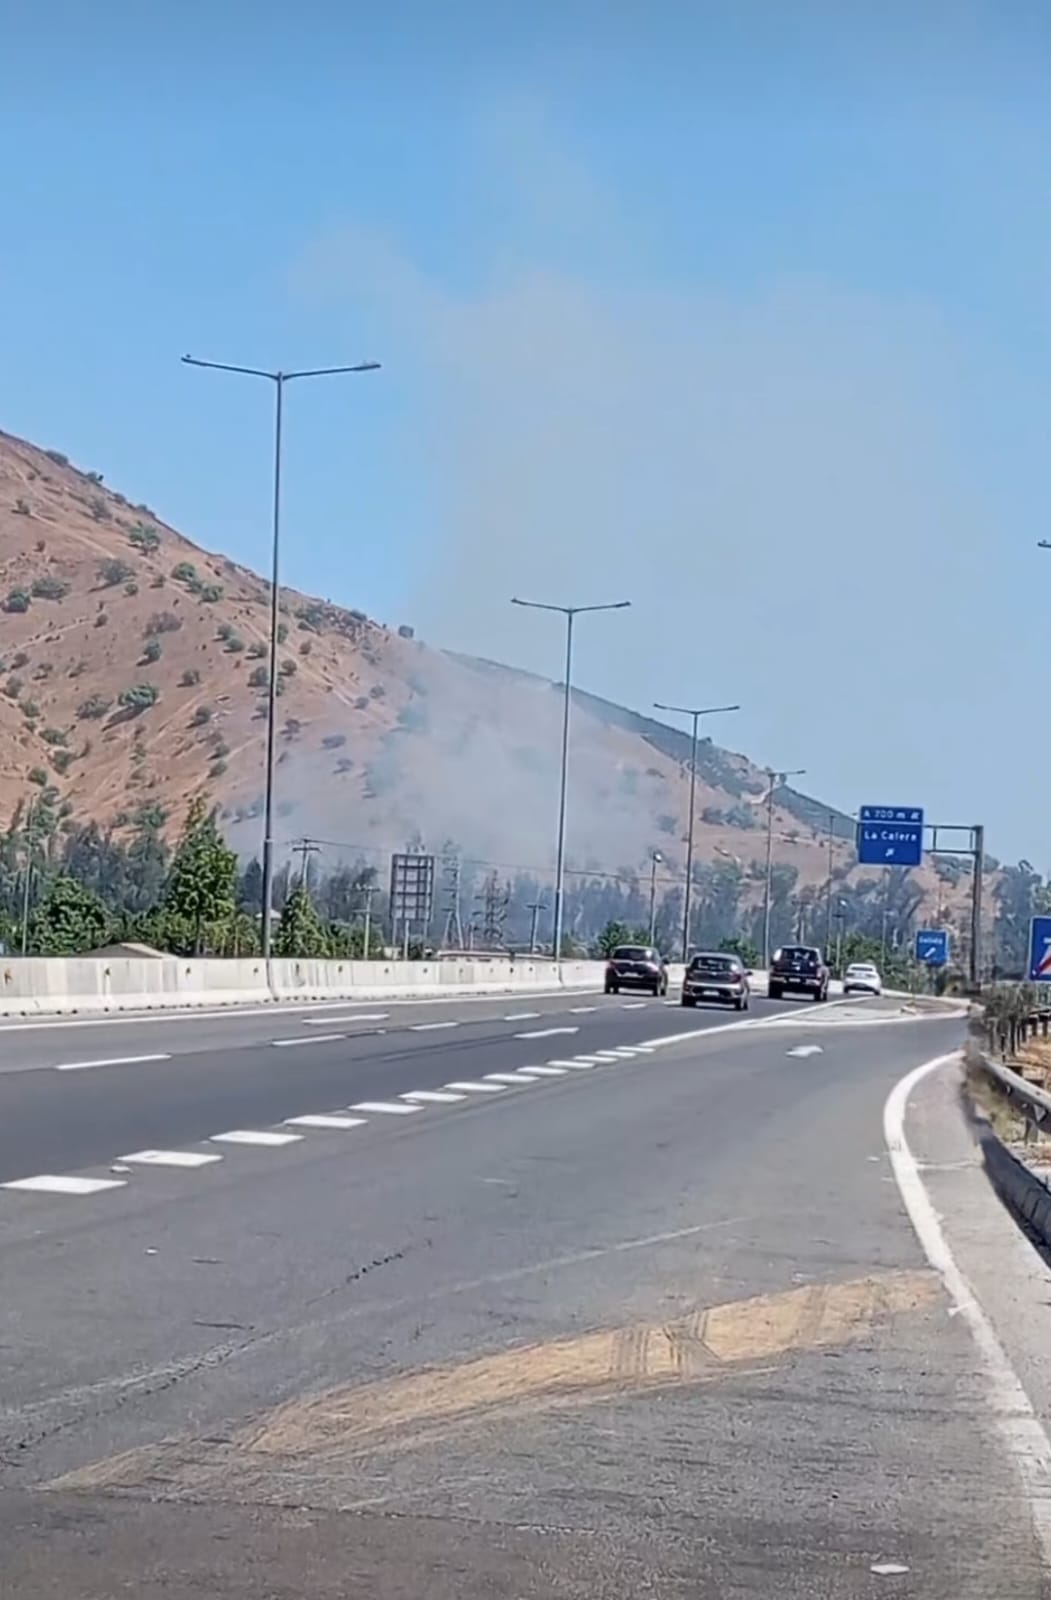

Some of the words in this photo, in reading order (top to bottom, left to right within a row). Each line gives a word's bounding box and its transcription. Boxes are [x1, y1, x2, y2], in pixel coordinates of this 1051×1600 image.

[864, 810, 870, 818] A
[864, 831, 878, 840] La
[881, 831, 917, 841] Calera
